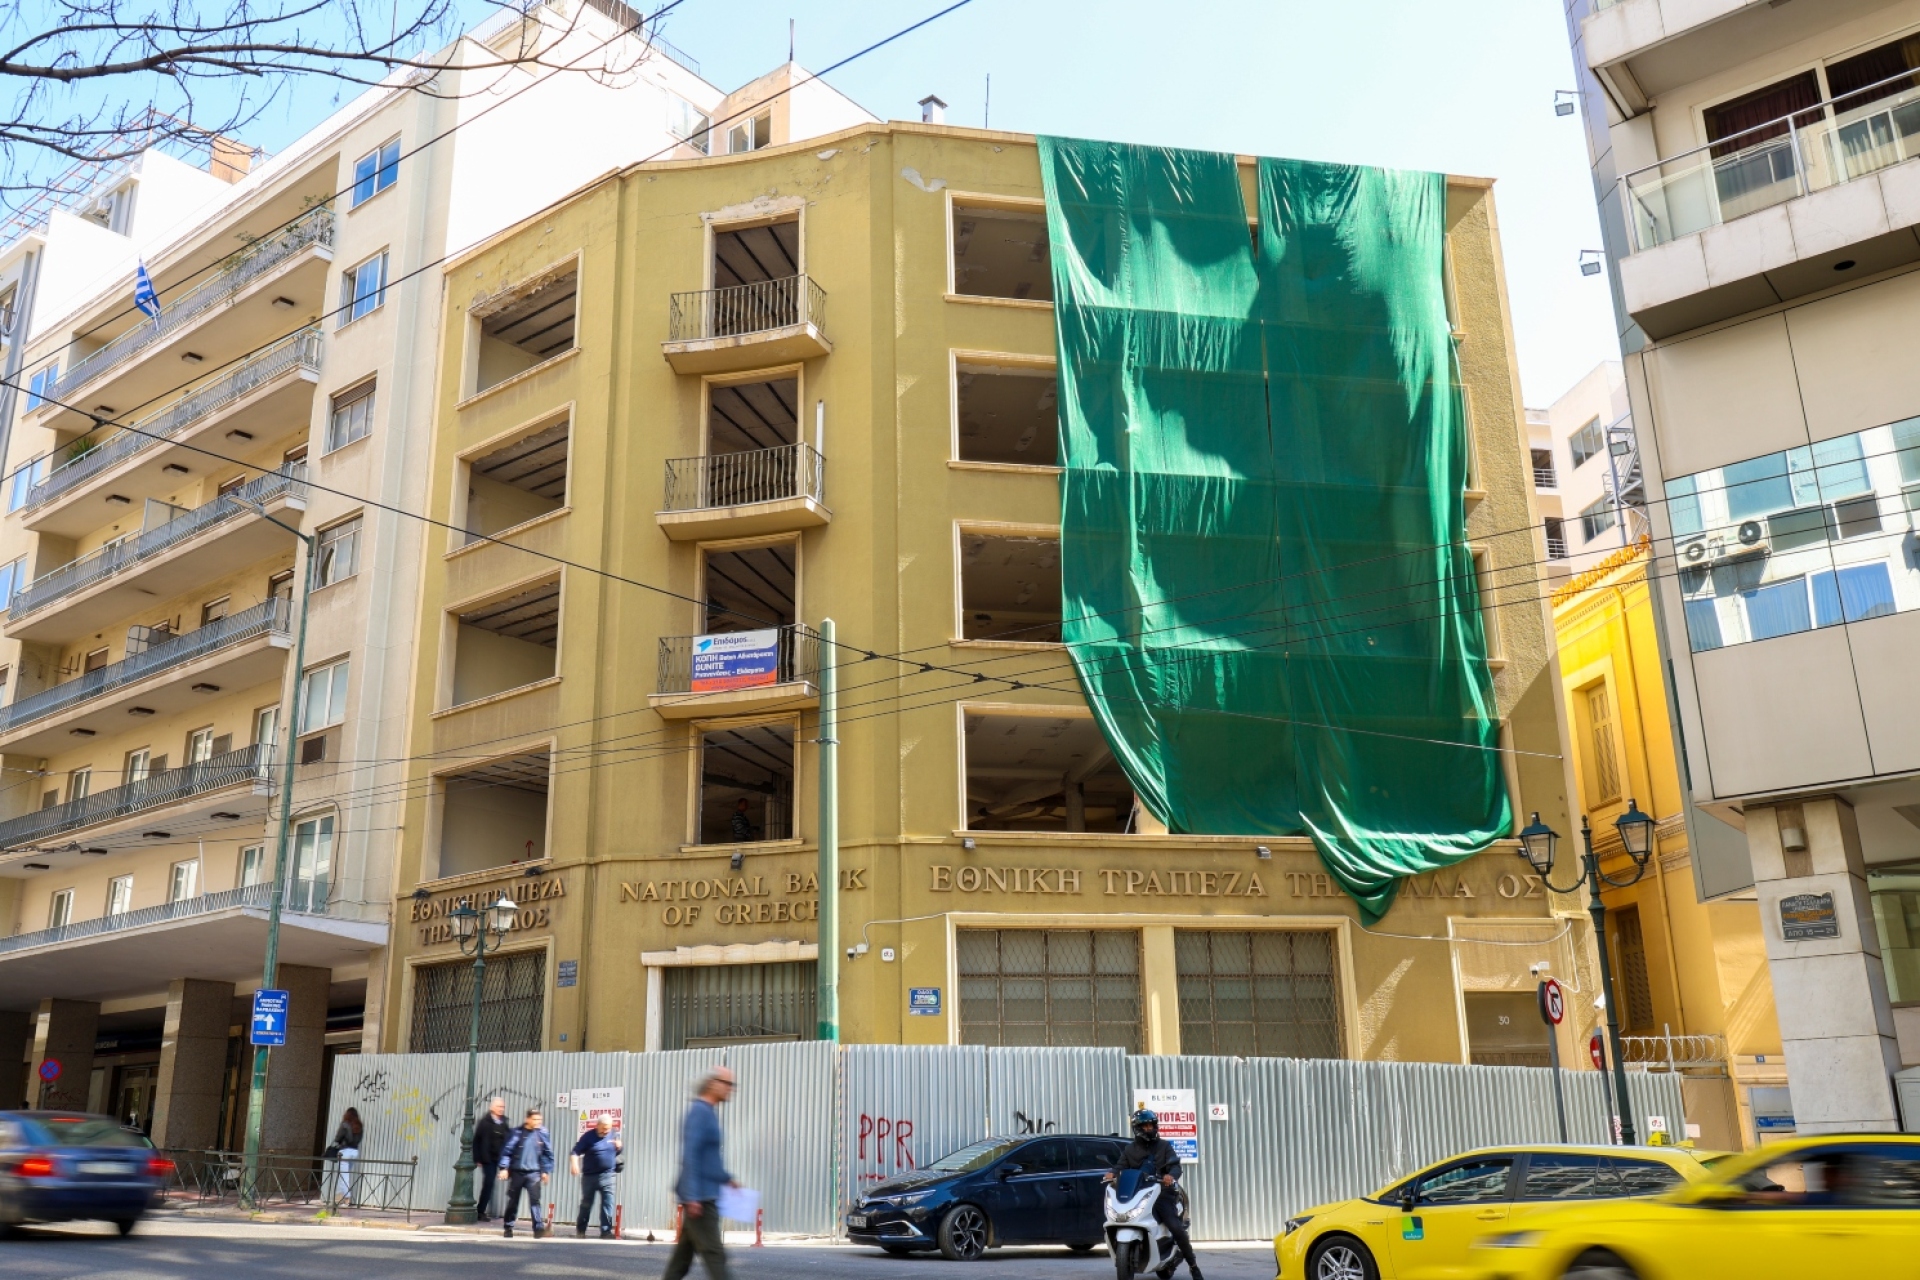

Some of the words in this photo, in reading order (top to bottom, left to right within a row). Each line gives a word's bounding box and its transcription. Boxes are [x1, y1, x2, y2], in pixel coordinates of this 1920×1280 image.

[695, 654, 718, 663] ΚΟΠΗ
[620, 875, 770, 903] NATIONAL
[785, 867, 867, 894] BAK
[929, 864, 1083, 894] ΕΘΝΙΚΗ
[1099, 868, 1269, 897] ΤΡΑΠΕΖΑ
[410, 892, 479, 923] ΕΘΝΙΚΗ
[661, 905, 701, 927] OF
[1498, 1016, 1510, 1025] 30
[1156, 1112, 1196, 1122] ΡΓΟΤΑΞΙΟ
[858, 1113, 915, 1169] PPR
